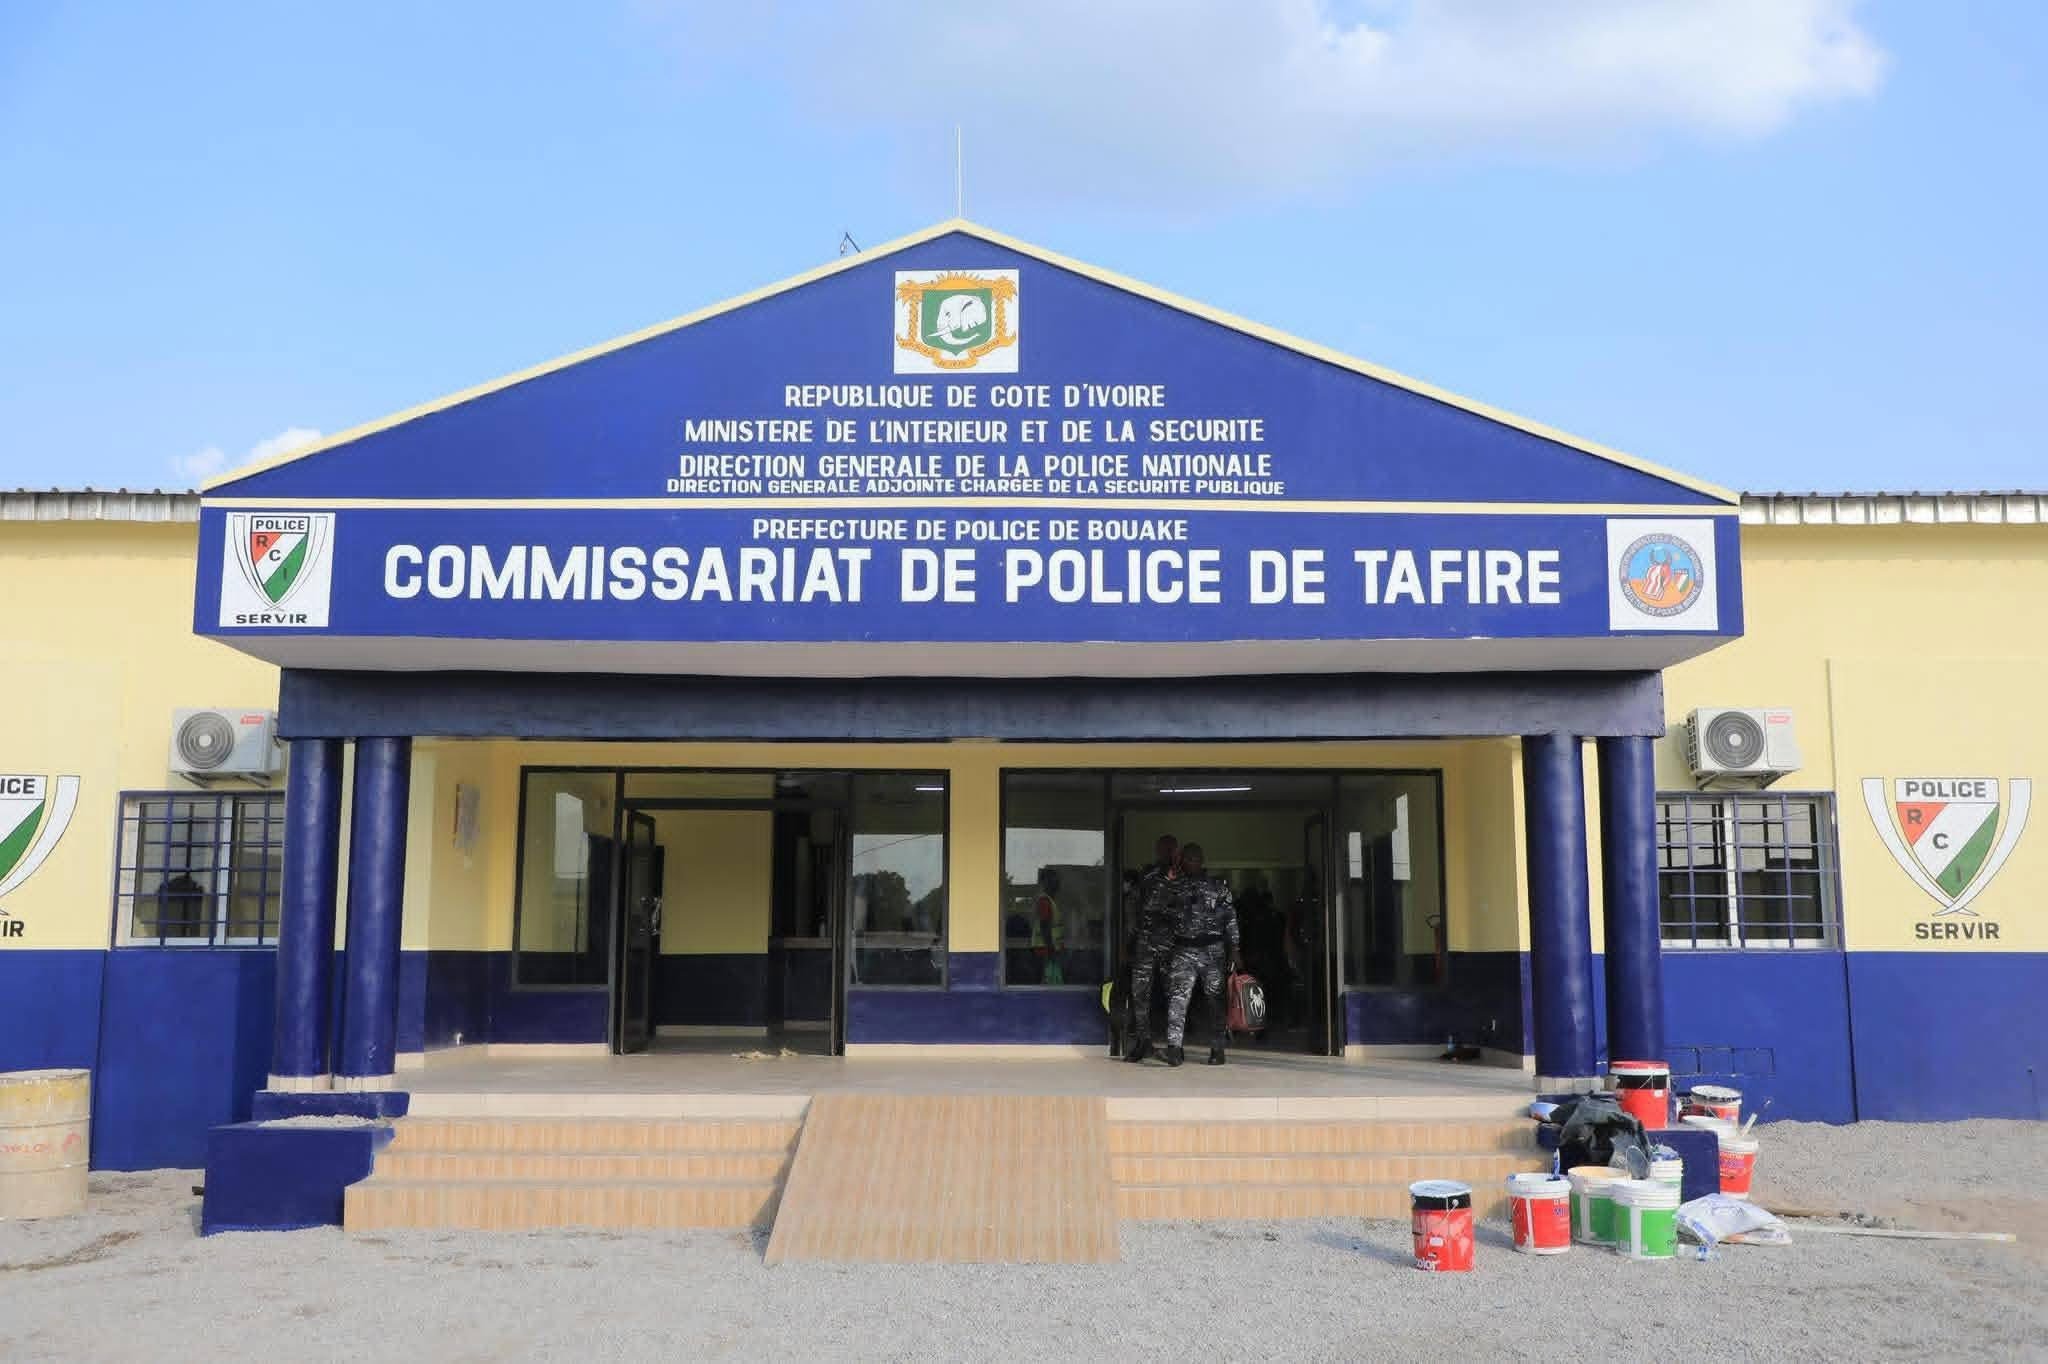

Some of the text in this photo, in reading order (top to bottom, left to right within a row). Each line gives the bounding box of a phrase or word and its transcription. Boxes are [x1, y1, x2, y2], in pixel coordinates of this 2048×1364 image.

[785, 383, 1166, 410] REPUBLIQUE DE COTE D'IVOIRE
[685, 419, 1265, 443] MINISTERE DE L'INTERIEUR ET DE LA SECURITE
[679, 454, 1272, 478] DIRECTION GENERALE DE LA POLICE NATIONALE
[666, 478, 1286, 496] DIRECTION GENERALE ADJOINTE CHARGEE DE LA SECURITE PUBLIQUE
[255, 519, 305, 531] POLICE
[752, 518, 1188, 542] PREFECTURE DE POLICE DE BOUAKE
[256, 534, 269, 548] R
[268, 549, 281, 562] C
[383, 544, 873, 604] COMMISSARIAT
[901, 547, 977, 604] DE
[1003, 548, 1222, 605] POLICE
[1249, 548, 1326, 605] DE
[1353, 549, 1562, 606] TAFIRE
[235, 613, 308, 625] SERVIR
[1904, 781, 1987, 798] POLICE
[1906, 808, 1923, 825] R
[1932, 833, 1949, 850] C
[1914, 922, 2000, 940] SERVIR
